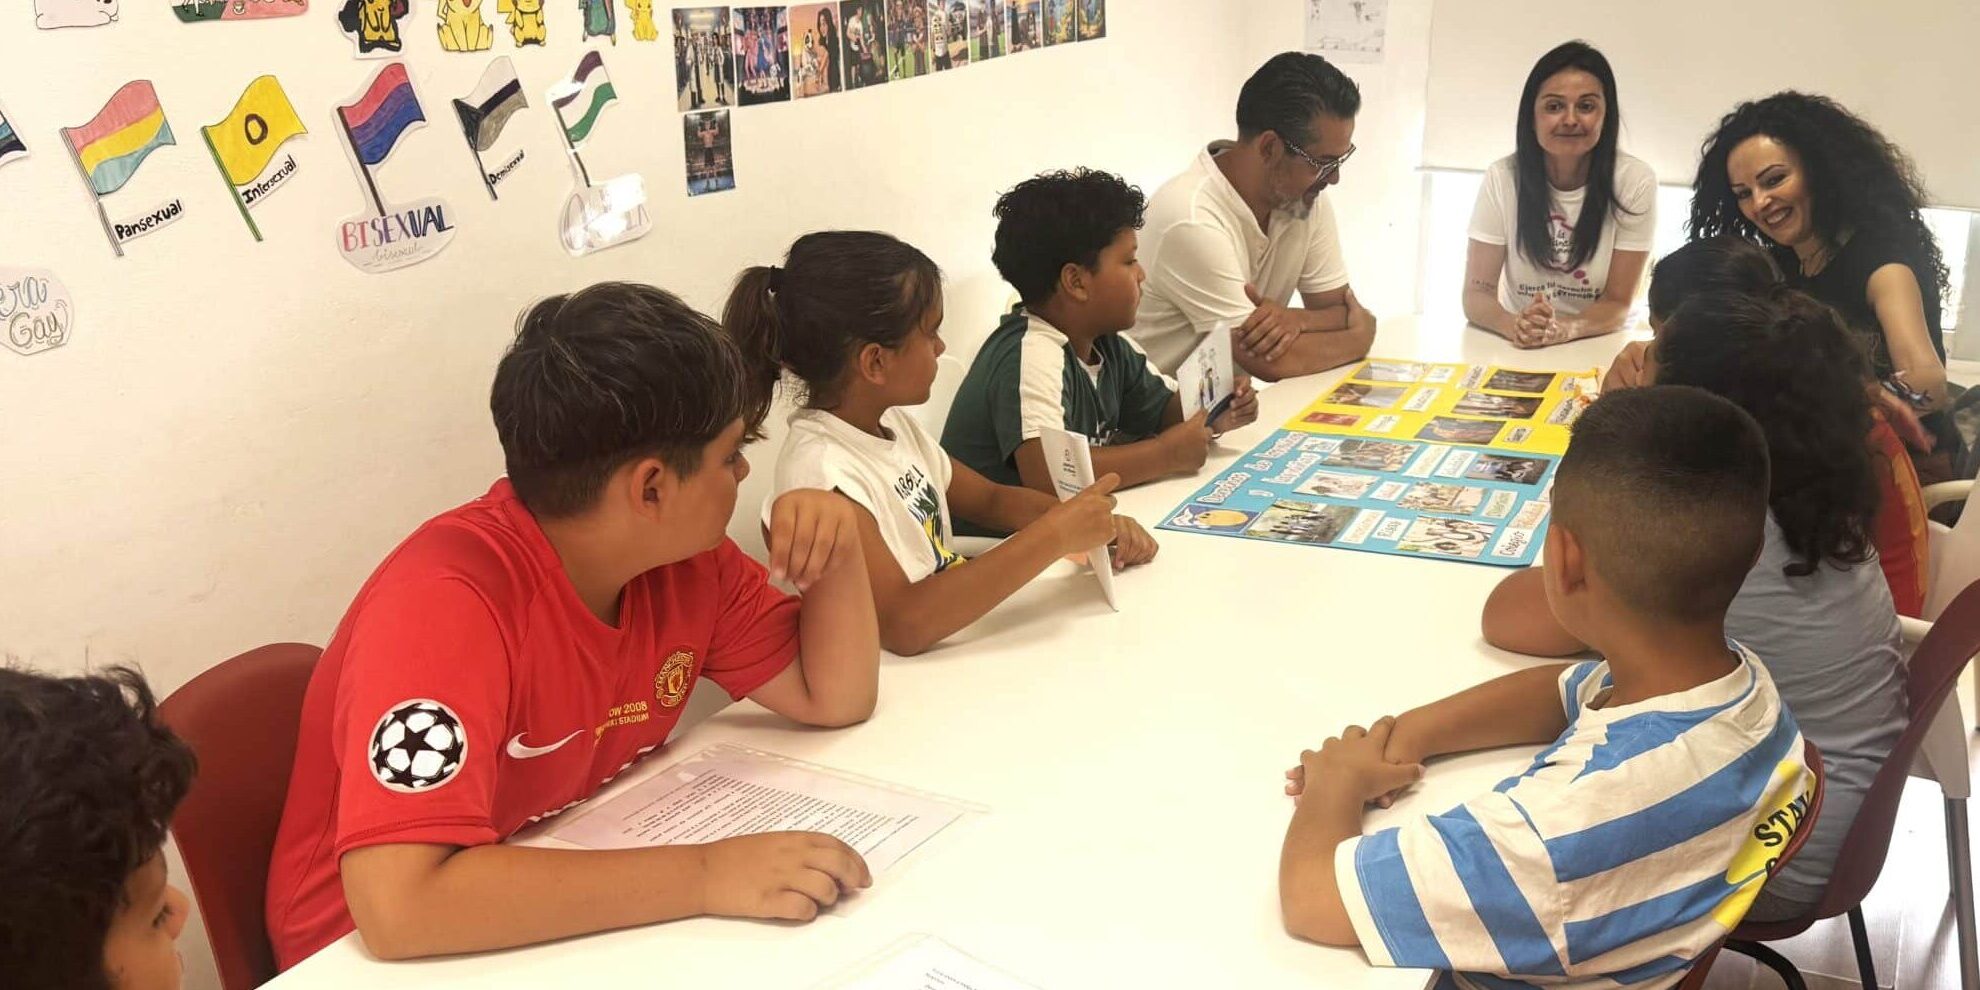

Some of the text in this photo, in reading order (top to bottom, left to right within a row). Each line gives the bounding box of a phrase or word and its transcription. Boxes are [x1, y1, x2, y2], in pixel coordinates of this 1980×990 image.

[242, 154, 297, 204] Intersexual
[115, 199, 182, 240] Pansexual
[342, 205, 454, 252] BISEXUAL
[10, 311, 64, 346] Gay
[619, 713, 649, 725] STADIUM
[623, 701, 648, 714] 2008
[1754, 790, 1810, 847] STAY
